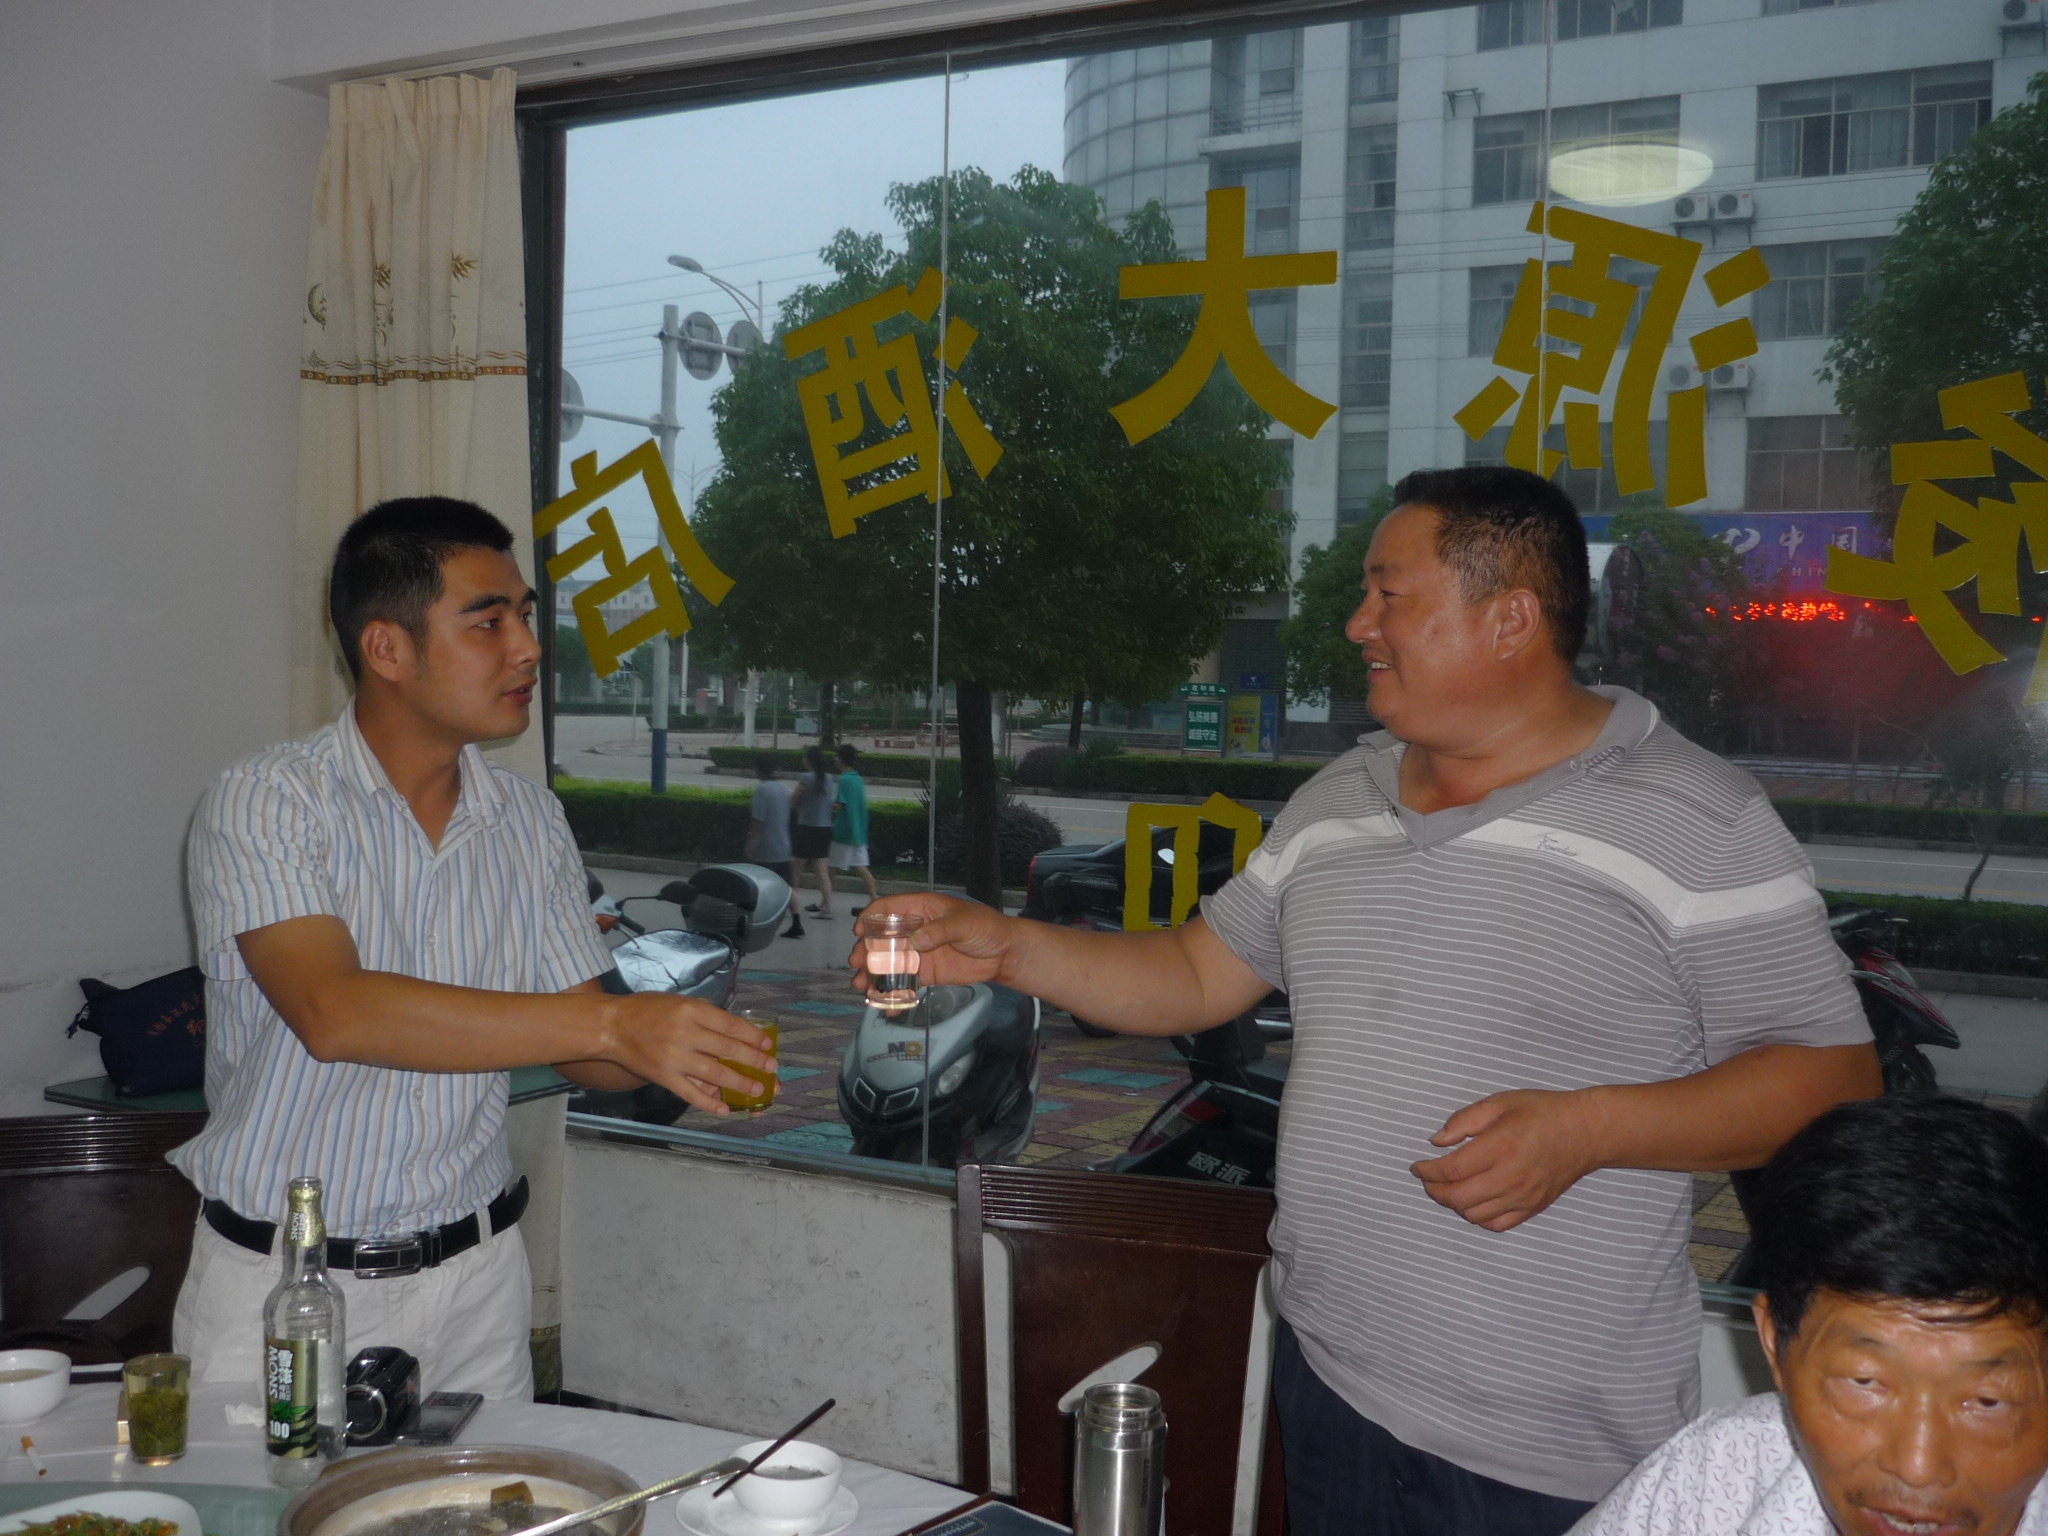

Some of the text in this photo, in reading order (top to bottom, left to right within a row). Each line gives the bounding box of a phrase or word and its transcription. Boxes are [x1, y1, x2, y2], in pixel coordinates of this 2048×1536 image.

[1187, 1151, 1251, 1186] 欧派
[291, 1212, 300, 1241] SNOW
[268, 1345, 279, 1399] SNOW
[270, 1420, 290, 1439] 100
